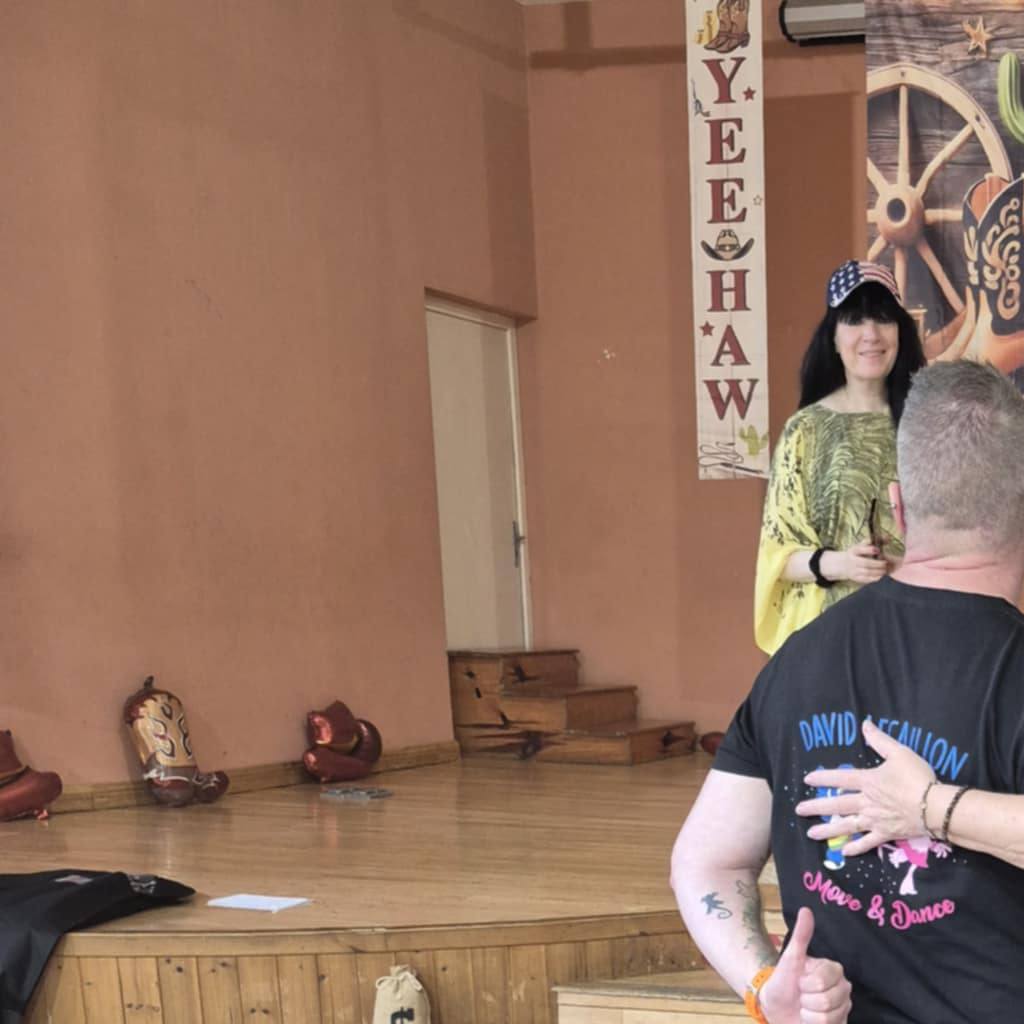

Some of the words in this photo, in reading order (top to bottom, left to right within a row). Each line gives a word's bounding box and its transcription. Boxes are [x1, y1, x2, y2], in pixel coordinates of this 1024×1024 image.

[798, 711, 858, 753] DAVID
[802, 870, 863, 911] Move
[866, 894, 885, 927] &
[890, 899, 956, 930] Dance
